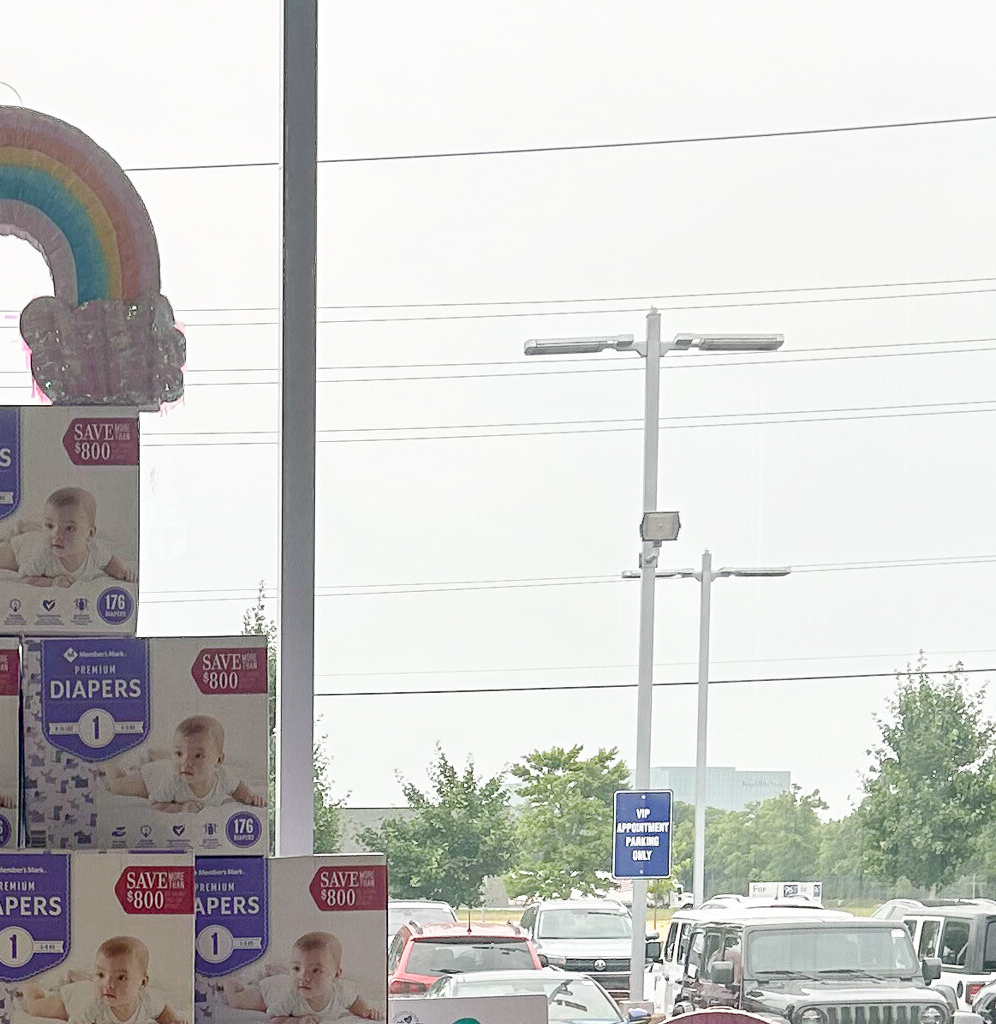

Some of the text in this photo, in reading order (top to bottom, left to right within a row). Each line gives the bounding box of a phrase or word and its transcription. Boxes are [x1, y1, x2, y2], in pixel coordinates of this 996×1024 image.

[73, 422, 113, 441] SAVE
[73, 441, 110, 461] $800
[105, 594, 126, 610] 176
[74, 664, 116, 675] PREMIUM
[202, 652, 241, 671] SAVE
[50, 678, 141, 700] DIAPERS
[202, 671, 238, 690] $800
[92, 715, 100, 740] 1
[635, 808, 651, 819] VIP
[233, 818, 254, 835] 176
[617, 822, 669, 833] APPOINTMENT
[625, 836, 660, 847] PARKING
[632, 850, 653, 861] ONLY
[126, 871, 168, 890] SAVE
[320, 870, 359, 888] SAVE
[126, 890, 164, 910] $800
[320, 888, 356, 907] $800
[10, 933, 17, 959] 1
